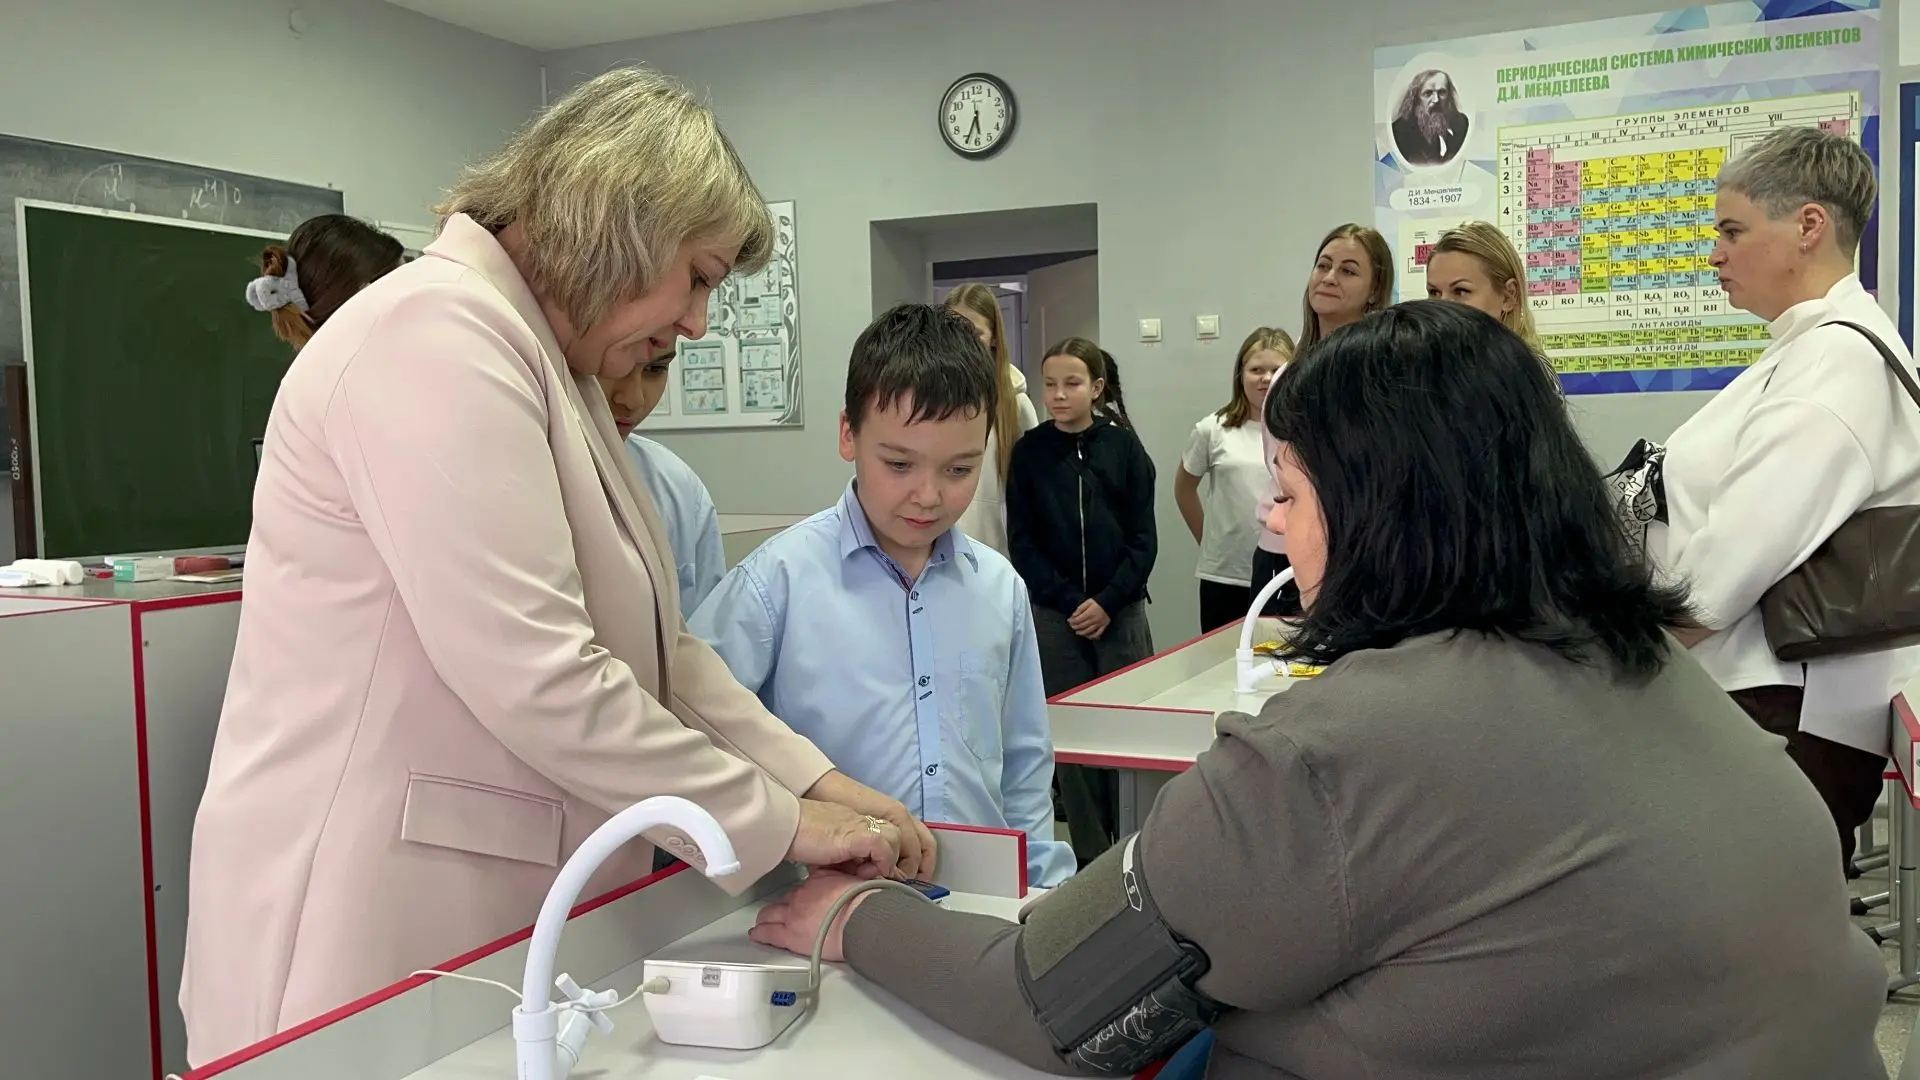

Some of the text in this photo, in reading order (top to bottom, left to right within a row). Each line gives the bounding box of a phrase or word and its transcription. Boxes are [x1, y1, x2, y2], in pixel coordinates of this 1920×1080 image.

[1497, 27, 1861, 83] ПЕРИОДИЧЕСКАЯ СИСТЕМА ХИМИЧЕСКИХ ЭЛЕМЕНТОВ
[972, 85, 982, 95] 12
[987, 89, 991, 97] 1
[1497, 75, 1610, 103] Д.И. МЕНДЕЛЕЕВА
[961, 91, 971, 100] 11
[953, 102, 963, 111] 10
[994, 98, 1001, 106] 2
[998, 110, 1004, 118] 3
[1617, 106, 1750, 126] ГРУППЫ ЭЛЕМЕНТОВ
[950, 115, 956, 123] 9
[954, 126, 960, 135] 8
[975, 138, 980, 146] 6
[987, 133, 992, 142] 5
[1504, 157, 1508, 165] 1
[1504, 172, 1509, 180] 2
[1504, 186, 1509, 194] 3
[1409, 197, 1429, 206] 1834
[1440, 194, 1461, 203] 1907
[1503, 207, 1509, 215] 4
[1632, 320, 1701, 329] ЛАНТАНОИДЫ
[1635, 344, 1698, 353] АКТИНОИДЫ
